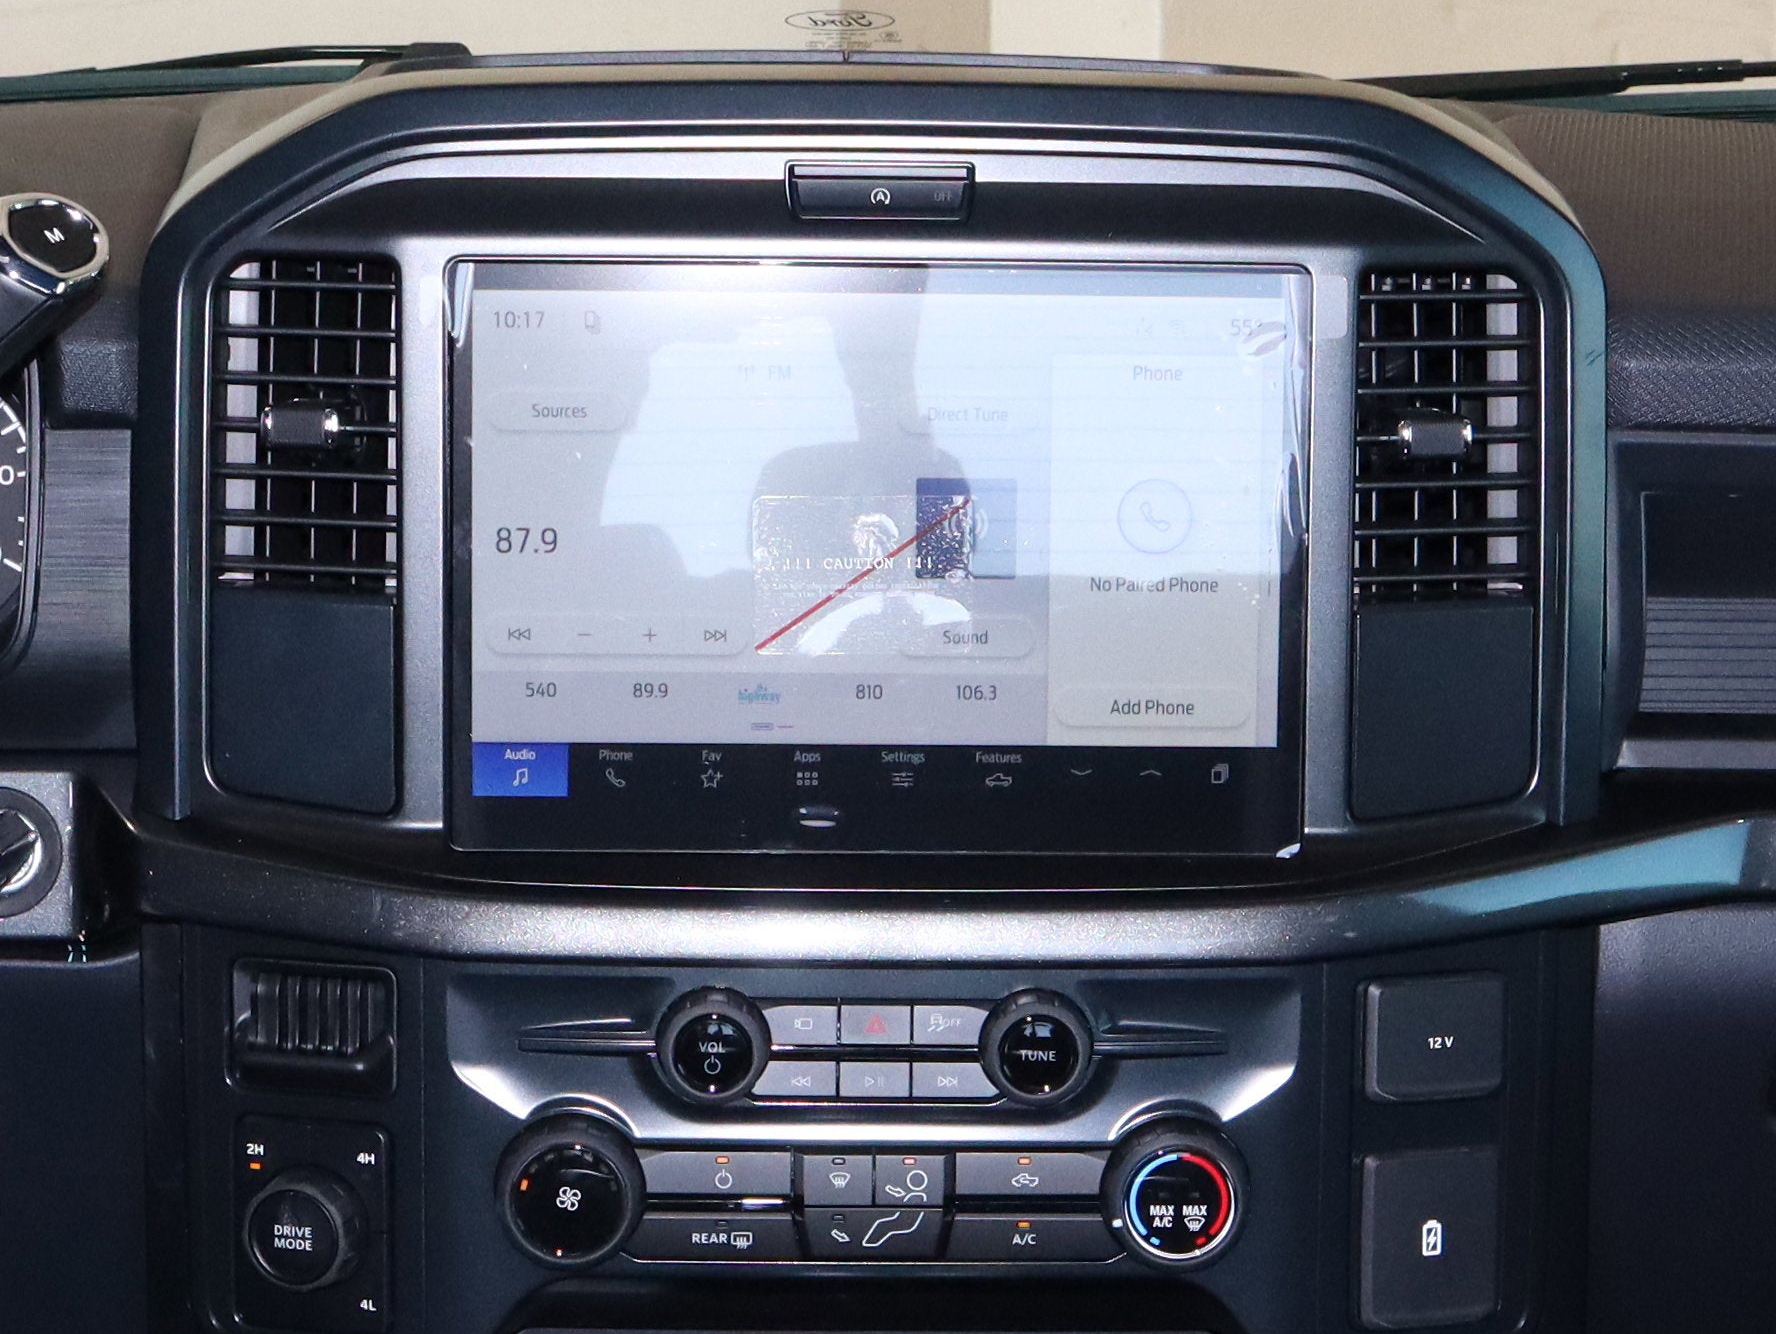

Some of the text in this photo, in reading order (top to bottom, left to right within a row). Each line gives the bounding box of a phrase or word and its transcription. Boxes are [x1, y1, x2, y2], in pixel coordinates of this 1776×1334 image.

[934, 192, 952, 202] OFF
[43, 227, 65, 244] M
[493, 310, 545, 329] 10:17
[1132, 364, 1184, 382] Phone
[531, 403, 588, 419] Sources
[927, 406, 1009, 424] Direct Tune
[495, 527, 558, 554] 87.9
[823, 557, 894, 570] CAUTION
[1089, 576, 1219, 593] No Paired Phone
[943, 629, 989, 648] Sound
[525, 681, 557, 698] 540
[632, 682, 669, 699] 89.9
[855, 683, 883, 700] 810
[956, 684, 997, 701] 106.3
[1110, 699, 1195, 716] Add Phone
[503, 748, 536, 760] Audio
[598, 749, 634, 761] Phone
[701, 750, 722, 762] Fav
[793, 750, 821, 764] Apps
[881, 750, 926, 765] Settings
[975, 752, 1023, 764] Features
[698, 1041, 726, 1054] VOL
[1428, 1036, 1454, 1049] 12 V
[1020, 1049, 1057, 1062] TUNE
[246, 1143, 264, 1156] 2H
[356, 1152, 375, 1165] 4H
[1149, 1204, 1208, 1216] MAX MAX
[1152, 1216, 1173, 1228] A/C
[274, 1224, 313, 1238] DRIVE
[691, 1232, 728, 1244] REAR
[1012, 1233, 1037, 1245] A/C
[274, 1239, 313, 1251] MODE
[359, 1299, 377, 1312] 4L
